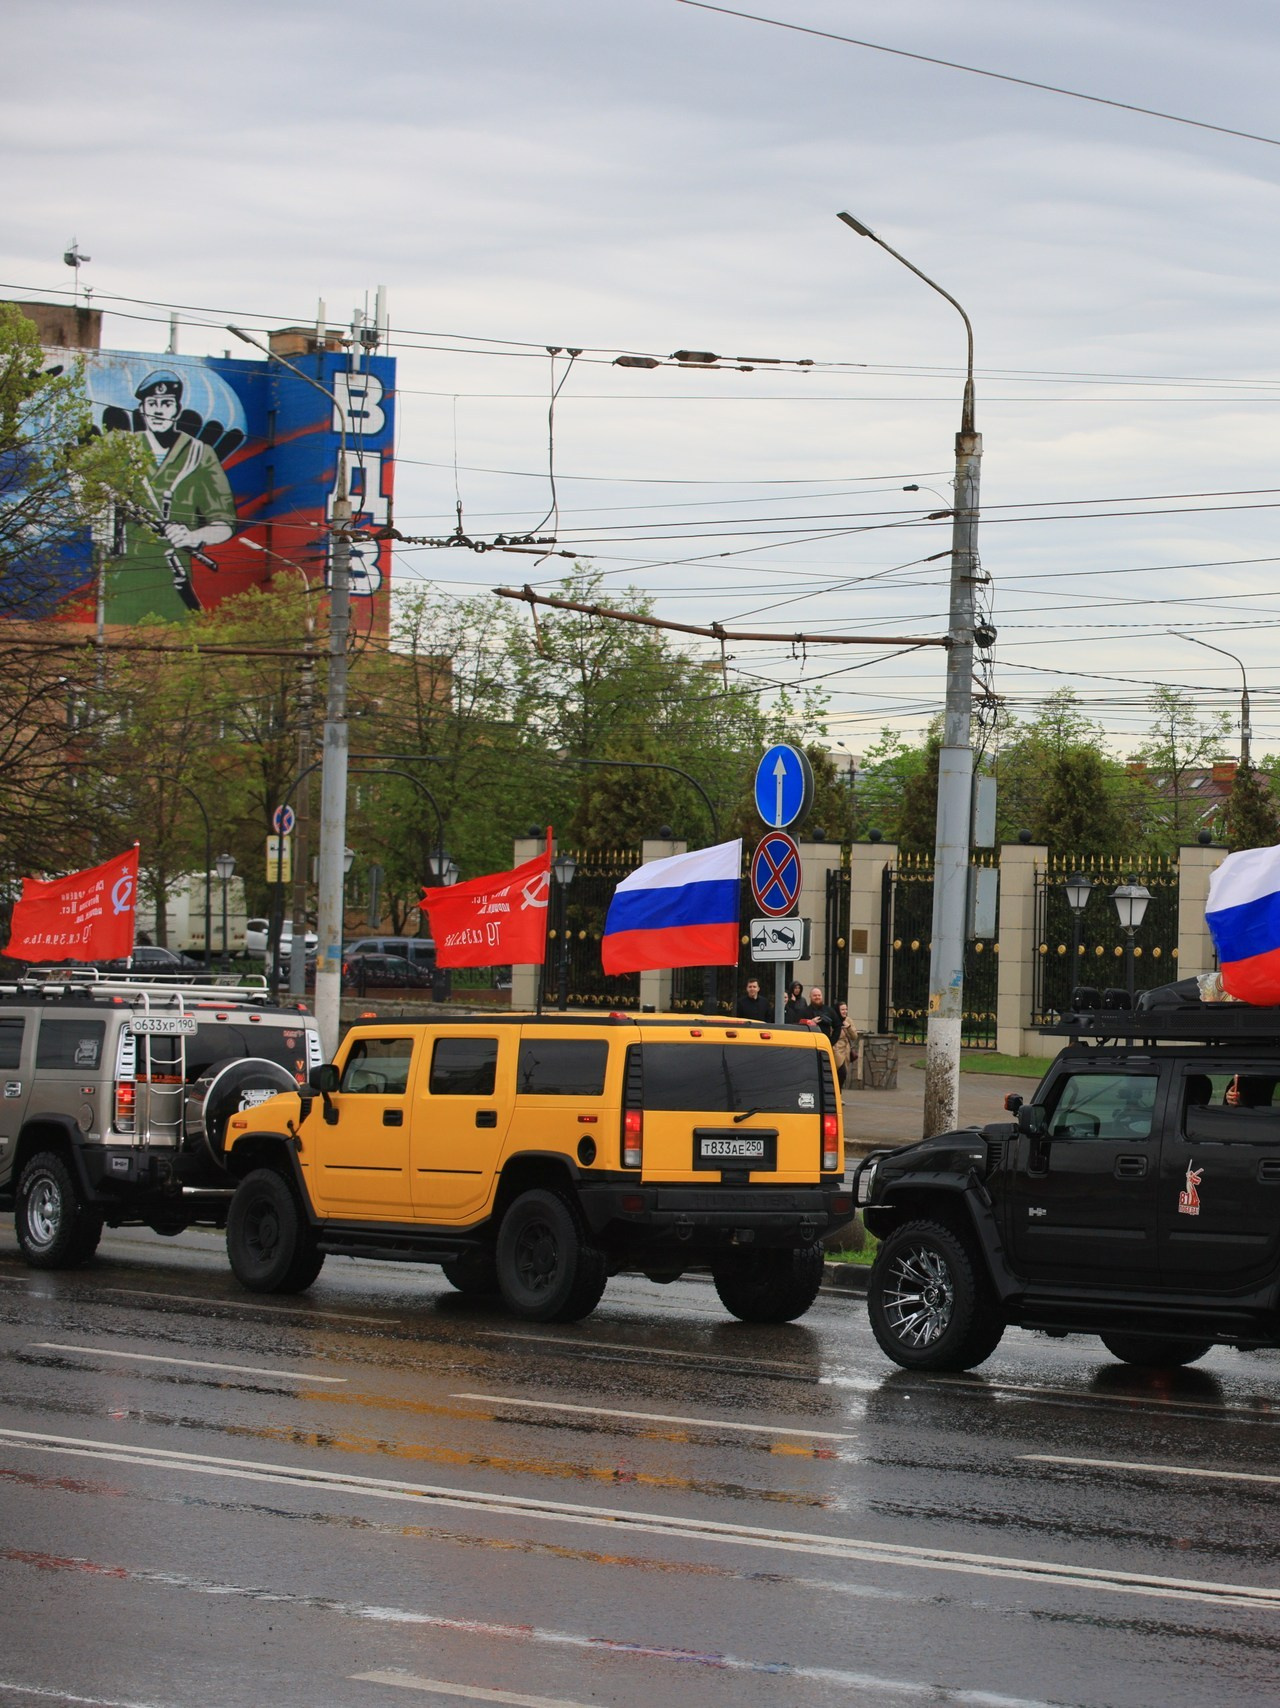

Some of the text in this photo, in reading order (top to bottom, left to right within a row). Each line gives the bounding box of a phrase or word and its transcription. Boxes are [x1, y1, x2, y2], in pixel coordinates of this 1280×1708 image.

[134, 1019, 193, 1031] О633ХР 190
[704, 1141, 762, 1155] Т833АЕ 250
